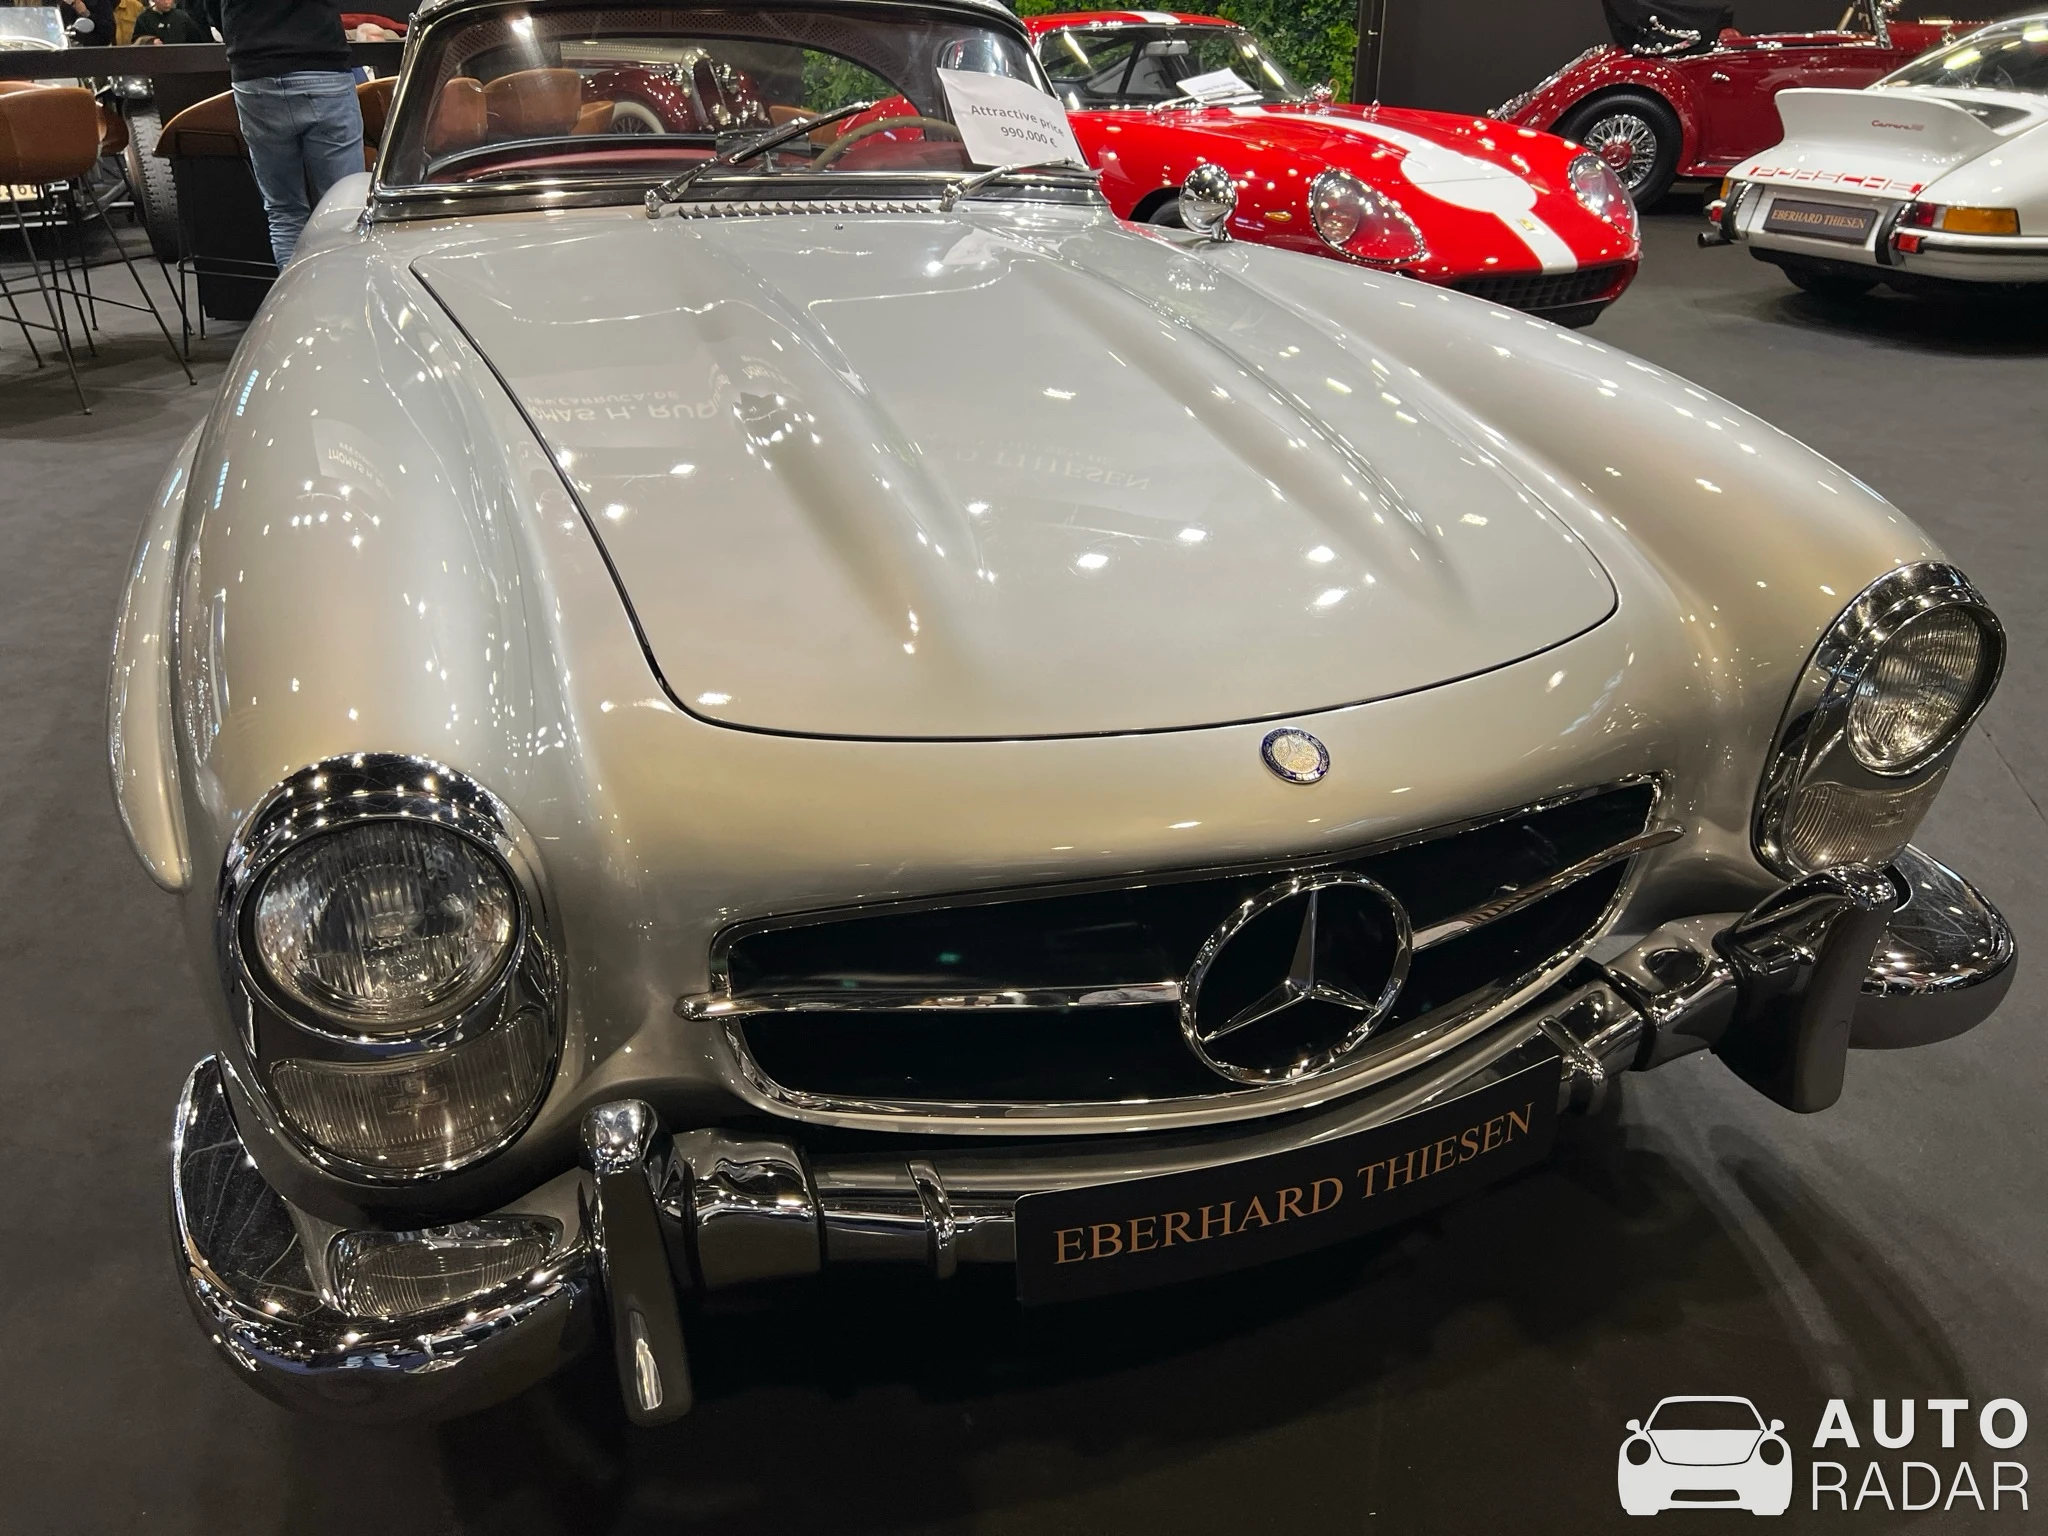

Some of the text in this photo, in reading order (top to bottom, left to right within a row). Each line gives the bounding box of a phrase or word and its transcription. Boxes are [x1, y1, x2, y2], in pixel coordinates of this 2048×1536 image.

[971, 105, 1065, 137] Attractive price
[1050, 137, 1058, 148] €
[1771, 209, 1867, 229] EBERHARD THIESEN
[1053, 1102, 1536, 1265] EBERHARD THIESEN
